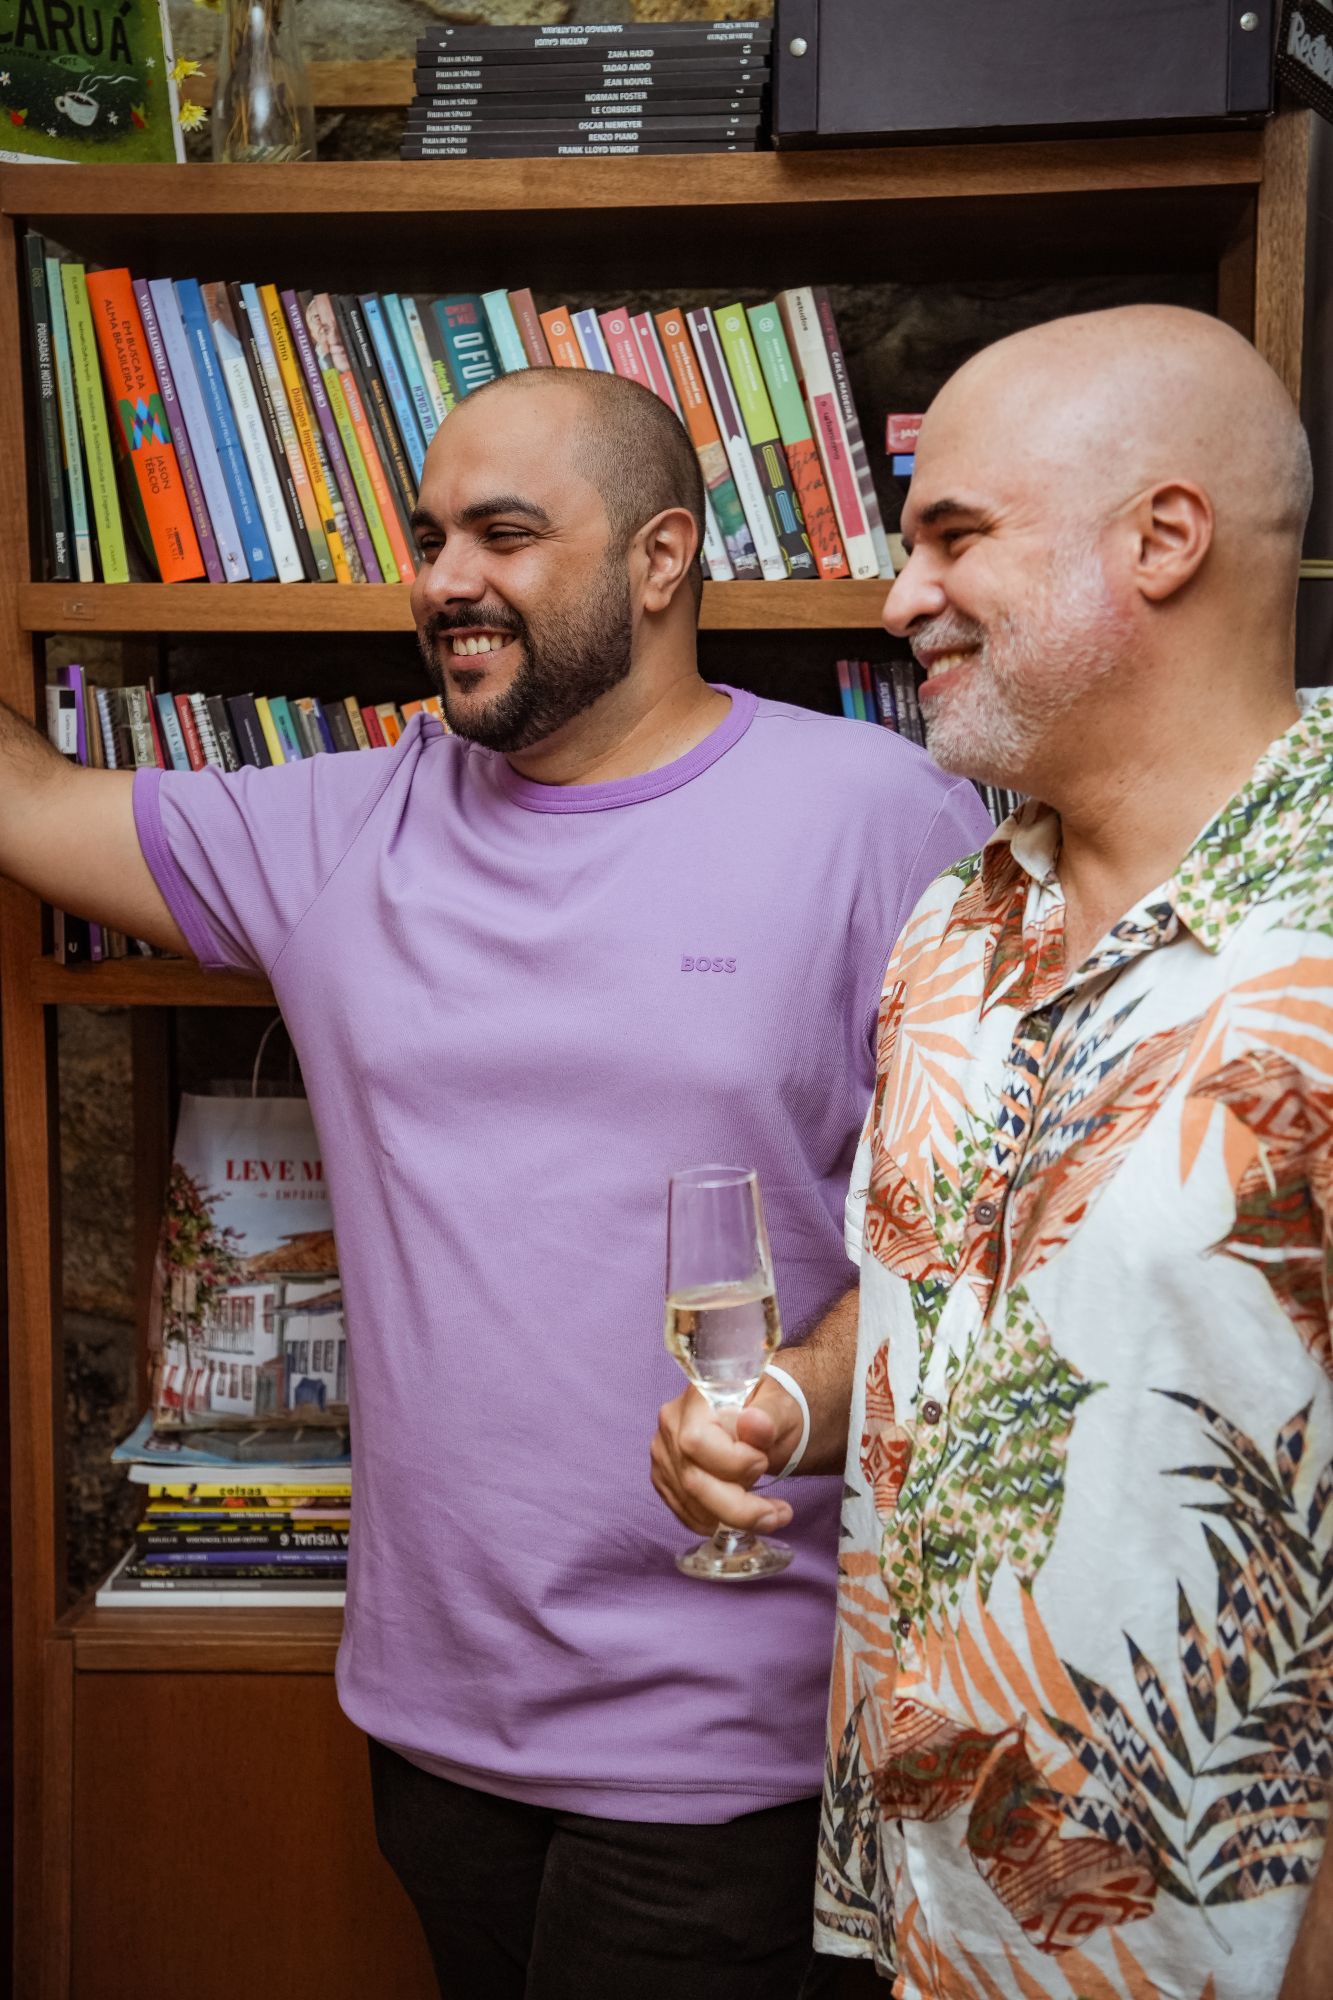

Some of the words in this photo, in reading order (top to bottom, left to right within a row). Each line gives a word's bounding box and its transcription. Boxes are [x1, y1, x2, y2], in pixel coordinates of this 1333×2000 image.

[560, 38, 590, 46] ANTONI
[630, 50, 654, 58] HADID
[629, 63, 652, 71] ANDO
[624, 78, 654, 86] NOUVEL
[585, 93, 619, 102] NORMAN
[620, 92, 648, 100] FOSTER
[602, 105, 642, 114] CORBUSIER
[578, 121, 604, 130] OSCAR
[605, 120, 642, 128] NIEMEYER
[140, 294, 152, 321] SILVA
[289, 303, 302, 330] SILVA
[796, 296, 808, 331] estudos
[453, 332, 484, 348] O
[697, 324, 708, 332] 10
[37, 322, 50, 362] POUSADAS
[104, 299, 118, 330] ALMA
[113, 332, 135, 392] BRASILEIRA
[122, 320, 130, 334] EM
[126, 336, 140, 373] BUSCA
[136, 374, 145, 390] DA
[160, 374, 175, 402] CRUZ
[313, 382, 327, 408] CRUZ
[832, 352, 842, 381] CARLA
[838, 382, 853, 420] MADEIRA
[291, 387, 307, 428] Diálogos
[303, 429, 322, 484] Impossíveis
[824, 412, 840, 460] urbanismo
[145, 458, 160, 494] TÉRCIO
[156, 455, 171, 490] JASON
[56, 532, 64, 564] Blucher
[681, 956, 736, 973] BOSS
[226, 1160, 294, 1182] LEVE
[220, 1485, 262, 1496] coisas
[280, 1534, 289, 1546] 6
[291, 1534, 339, 1546] VISUAL
